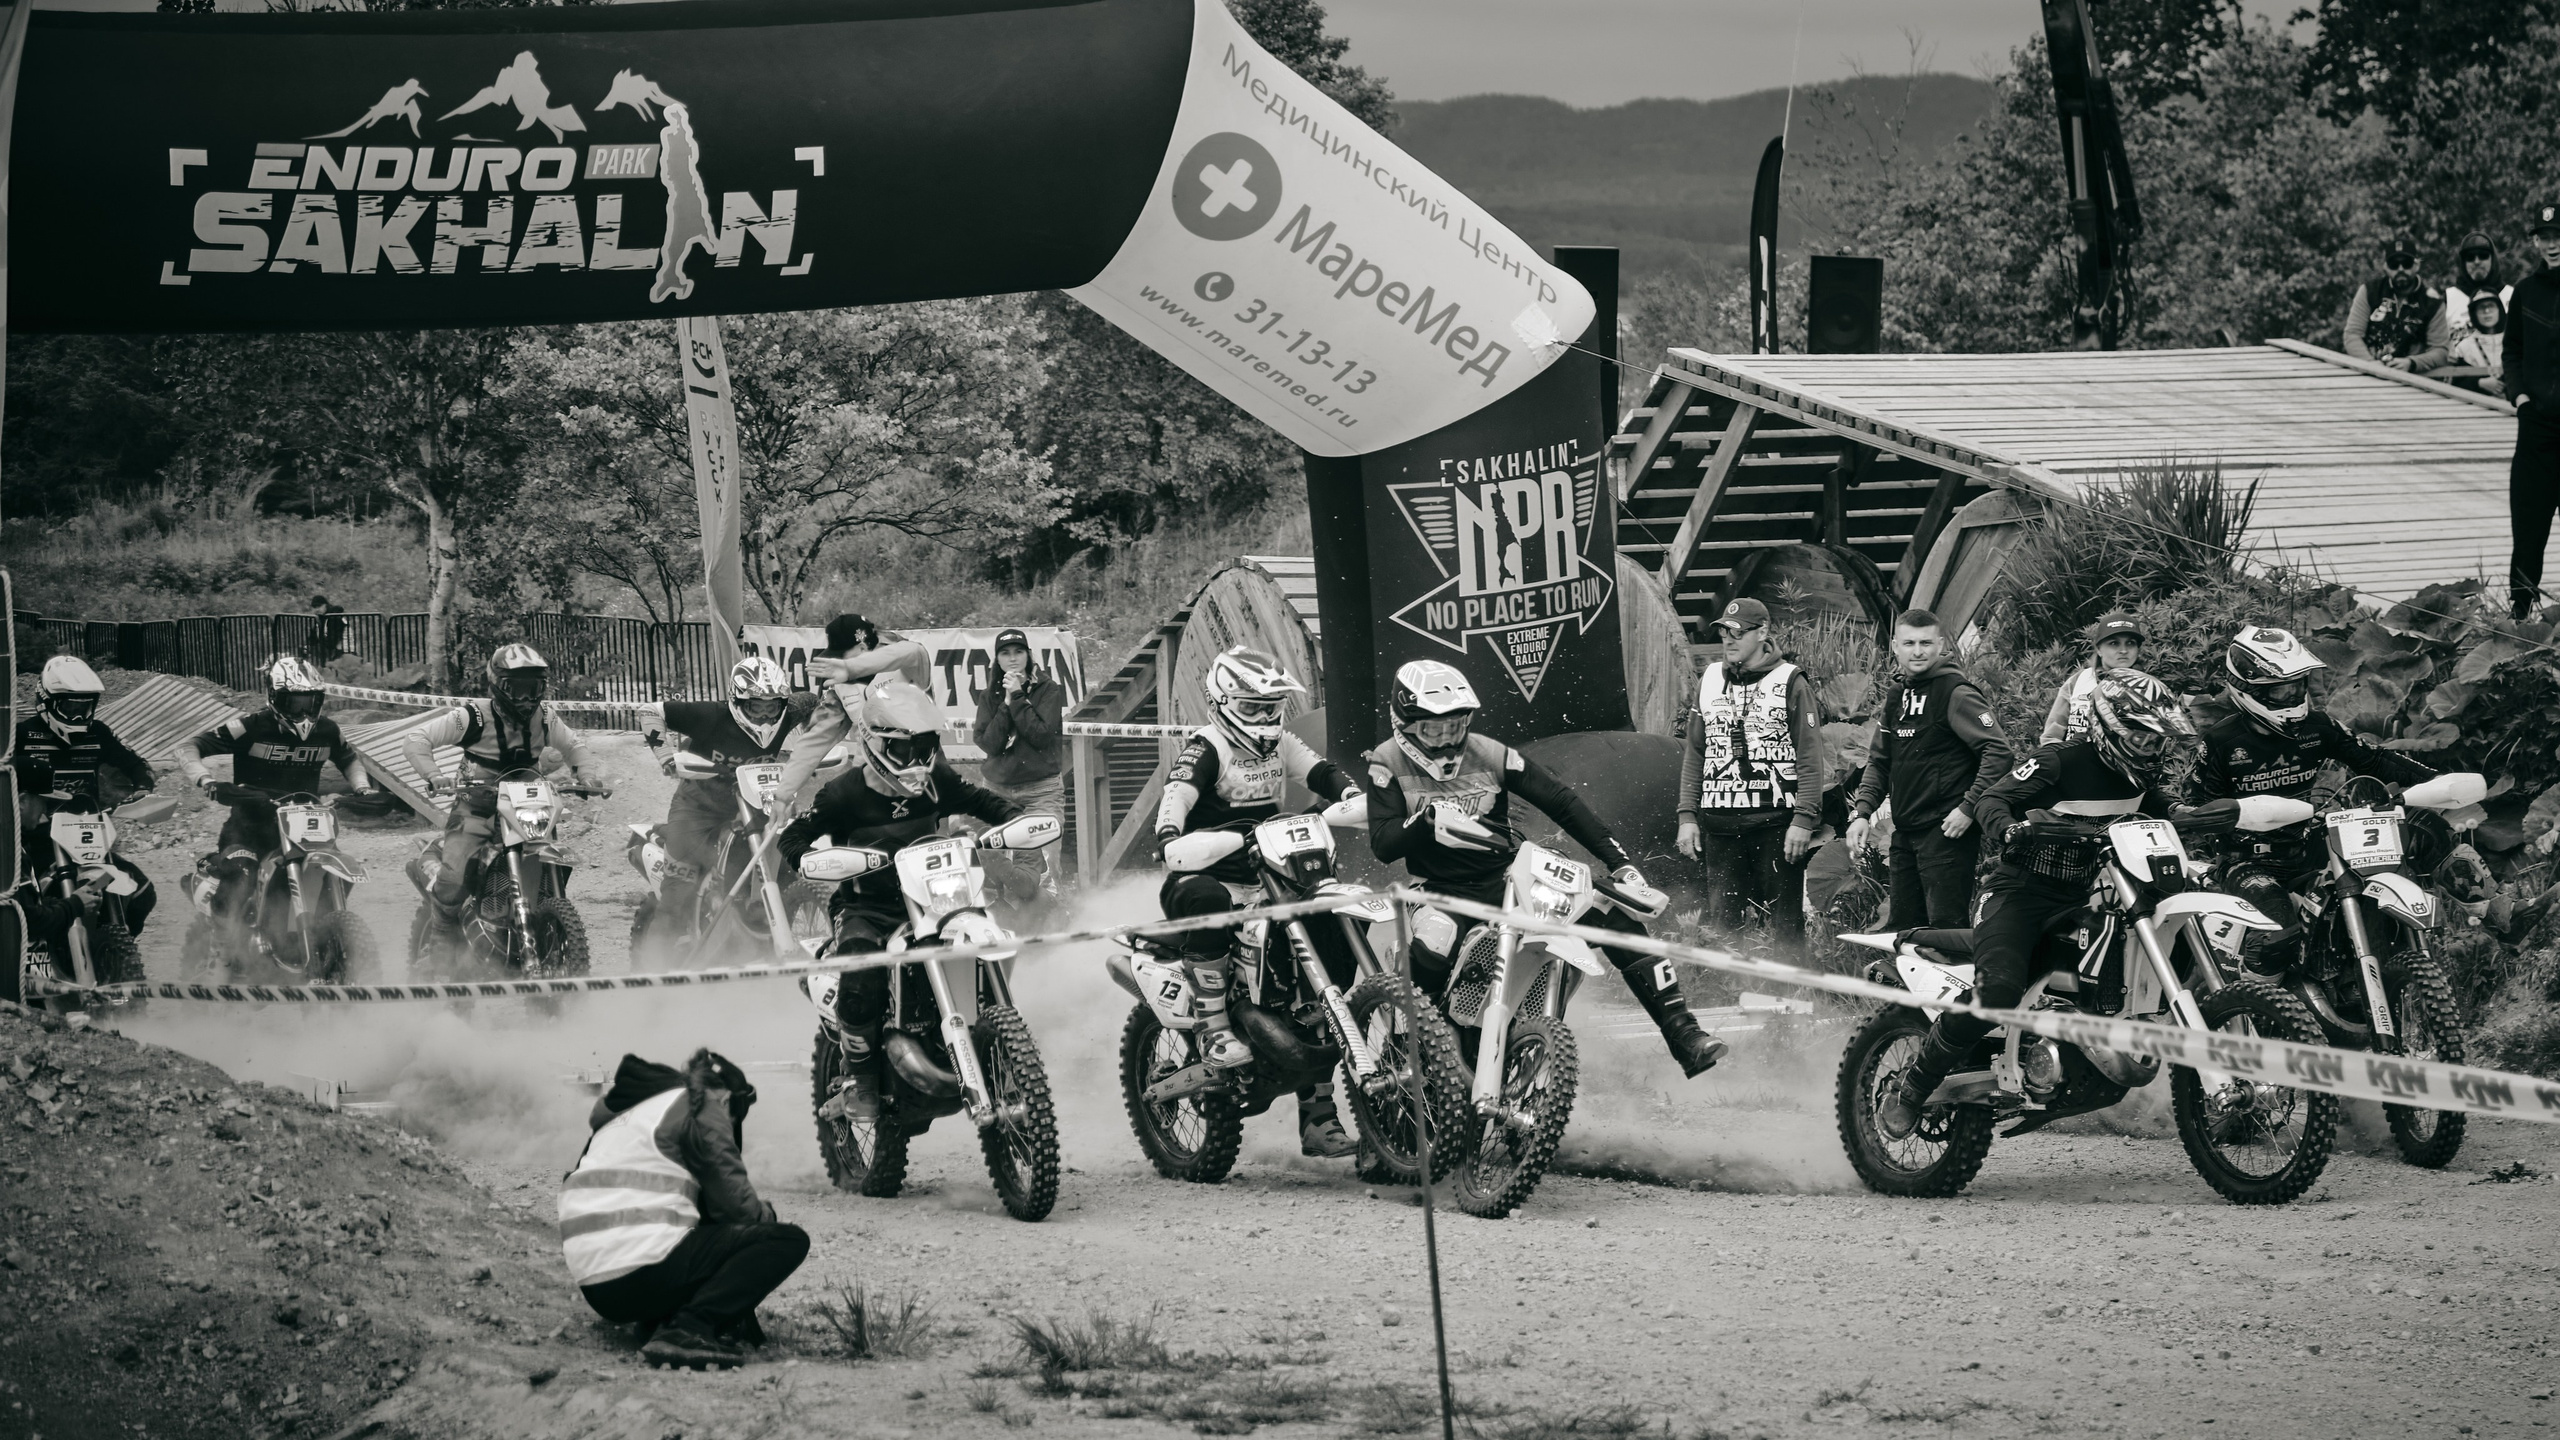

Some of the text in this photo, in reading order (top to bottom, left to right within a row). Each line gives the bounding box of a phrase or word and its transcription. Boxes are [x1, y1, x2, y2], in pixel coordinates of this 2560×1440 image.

[247, 142, 651, 192] ENDURO PARK
[1222, 43, 1559, 306] Медицинский Центр
[1274, 205, 1512, 389] МареМед
[1139, 281, 1360, 431] www.maremed.ru
[1235, 298, 1378, 397] 31-13-13
[1456, 441, 1570, 485] SAKHALIN
[1455, 470, 1580, 598] NPR
[1425, 576, 1601, 631] NO PLACE TO RUN
[1507, 626, 1550, 645] EXTREME
[1510, 640, 1548, 656] ENDURO
[1515, 652, 1544, 667] RALLY
[757, 774, 780, 785] 94
[2237, 767, 2318, 792] VLADIVOSTOK
[2243, 768, 2290, 782] ENDURO
[526, 788, 538, 798] 5
[307, 818, 319, 830] 9
[1287, 818, 1310, 826] GOLD
[81, 831, 93, 844] 2
[1285, 827, 1311, 843] 13
[2146, 832, 2158, 846] 1
[2363, 829, 2380, 847] 3
[928, 843, 953, 852] GOLD
[926, 852, 953, 871] 21
[1554, 858, 1577, 871] GOLD
[1544, 862, 1576, 884] 46
[2215, 920, 2233, 938] 3
[1169, 972, 1187, 982] GOLD
[1945, 976, 1967, 990] GOLD
[1159, 980, 1182, 1001] 13
[2378, 1005, 2391, 1032] GRIP
